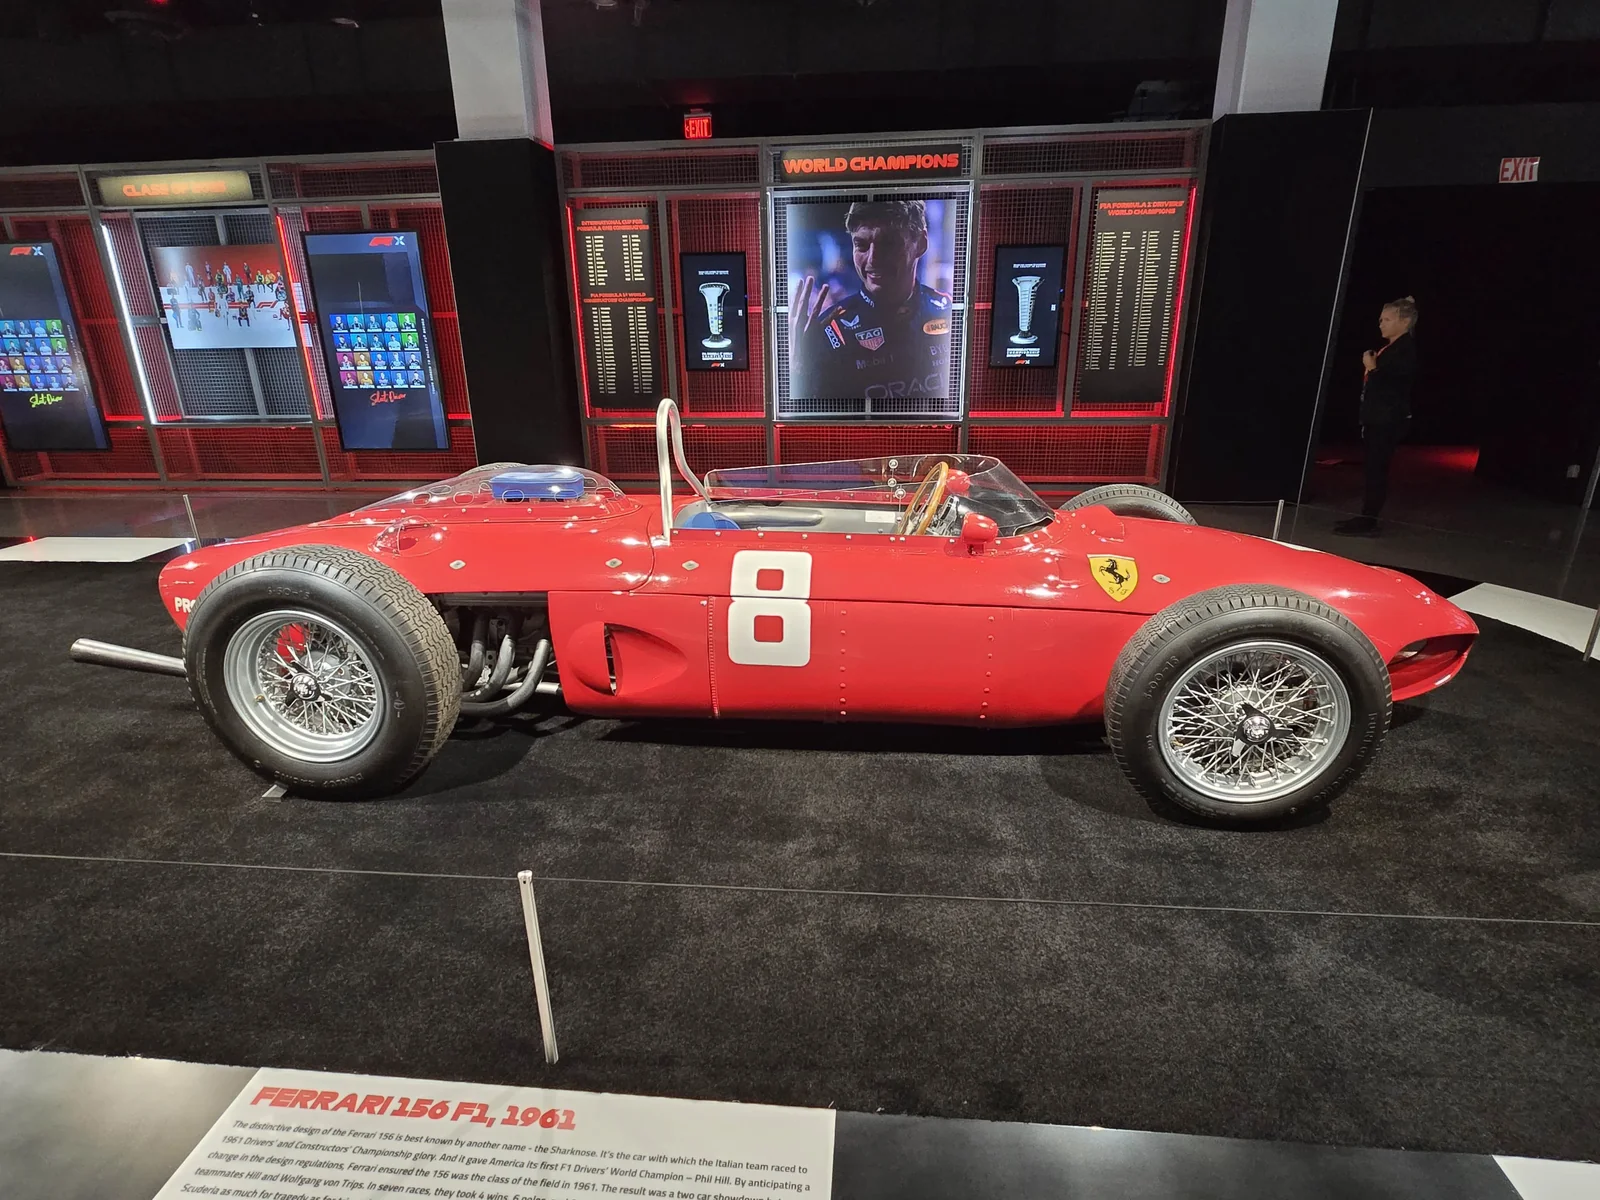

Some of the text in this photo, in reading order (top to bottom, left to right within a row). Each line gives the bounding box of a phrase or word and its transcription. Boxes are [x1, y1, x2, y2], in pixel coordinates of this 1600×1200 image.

[689, 119, 709, 137] EXIT
[783, 153, 959, 174] WORLD CHAMPIONS
[1501, 158, 1538, 181] EXIT
[1133, 208, 1176, 216] CHAMPIONS
[858, 329, 880, 340] TAG
[727, 550, 813, 667] 8
[250, 1086, 576, 1130] FERRARI 156 F1, 1961
[233, 1120, 249, 1129] The
[249, 1122, 292, 1132] distinctive
[293, 1125, 321, 1136] design
[322, 1127, 334, 1135] of
[332, 1128, 346, 1137] the
[347, 1129, 376, 1139] Ferrari
[379, 1132, 394, 1141] 156
[395, 1133, 403, 1142] is
[404, 1134, 423, 1143] best
[424, 1135, 453, 1146] known
[455, 1138, 466, 1148] by
[466, 1140, 501, 1150] another
[501, 1144, 526, 1152] name
[534, 1144, 549, 1154] the
[550, 1146, 598, 1158] Sharknose.
[616, 1152, 631, 1160] the
[632, 1154, 647, 1162] car
[648, 1154, 668, 1164] with
[670, 1156, 696, 1166] which
[698, 1158, 714, 1167] the
[715, 1159, 744, 1169] Italian
[745, 1162, 769, 1171] team
[770, 1164, 796, 1173] raced
[798, 1165, 808, 1174] to
[207, 1151, 239, 1163] change
[240, 1153, 249, 1161] in
[250, 1154, 265, 1163] the
[265, 1155, 294, 1167] design
[295, 1158, 345, 1170] regulations,
[347, 1162, 378, 1172] Ferrari
[378, 1167, 415, 1177] ensured
[415, 1168, 430, 1177] the
[433, 1170, 450, 1179] 156
[451, 1172, 469, 1180] was
[471, 1173, 486, 1182] the
[487, 1174, 510, 1184] class
[511, 1177, 523, 1185] of
[523, 1177, 538, 1186] the
[540, 1178, 560, 1189] field
[561, 1181, 571, 1189] in
[573, 1181, 598, 1192] 1961.
[601, 1183, 618, 1193] The
[619, 1186, 647, 1196] result
[648, 1190, 667, 1198] was
[676, 1190, 695, 1200] two
[222, 1135, 244, 1144] 1961
[243, 1137, 278, 1147] Drivers'
[277, 1141, 295, 1149] and
[295, 1141, 352, 1153] Constructors'
[352, 1145, 413, 1160] Championship
[412, 1151, 437, 1162] glory.
[439, 1153, 458, 1162] And
[458, 1154, 466, 1163] it
[465, 1157, 488, 1166] gave
[488, 1157, 525, 1168] America
[526, 1160, 538, 1169] its
[539, 1161, 558, 1171] first
[560, 1163, 571, 1171] F1
[573, 1164, 609, 1175] Drivers'
[610, 1167, 637, 1178] World
[639, 1169, 684, 1182] Champion
[694, 1174, 713, 1183] Phil
[714, 1176, 732, 1185] Hill.
[734, 1177, 746, 1188] By
[748, 1179, 803, 1193] anticipating
[180, 1183, 221, 1196] Scuderia
[220, 1188, 232, 1196] as
[232, 1189, 258, 1198] much
[259, 1190, 273, 1199] for
[194, 1167, 245, 1179] teammates
[245, 1171, 261, 1180] Hill
[261, 1173, 280, 1182] and
[280, 1174, 322, 1188] Wolfgang
[323, 1179, 340, 1187] von
[341, 1179, 364, 1190] Trips.
[367, 1181, 377, 1190] In
[377, 1183, 404, 1193] seven
[404, 1186, 431, 1196] races,
[434, 1187, 455, 1199] they
[456, 1190, 477, 1199] took
[478, 1191, 485, 1200] 4
